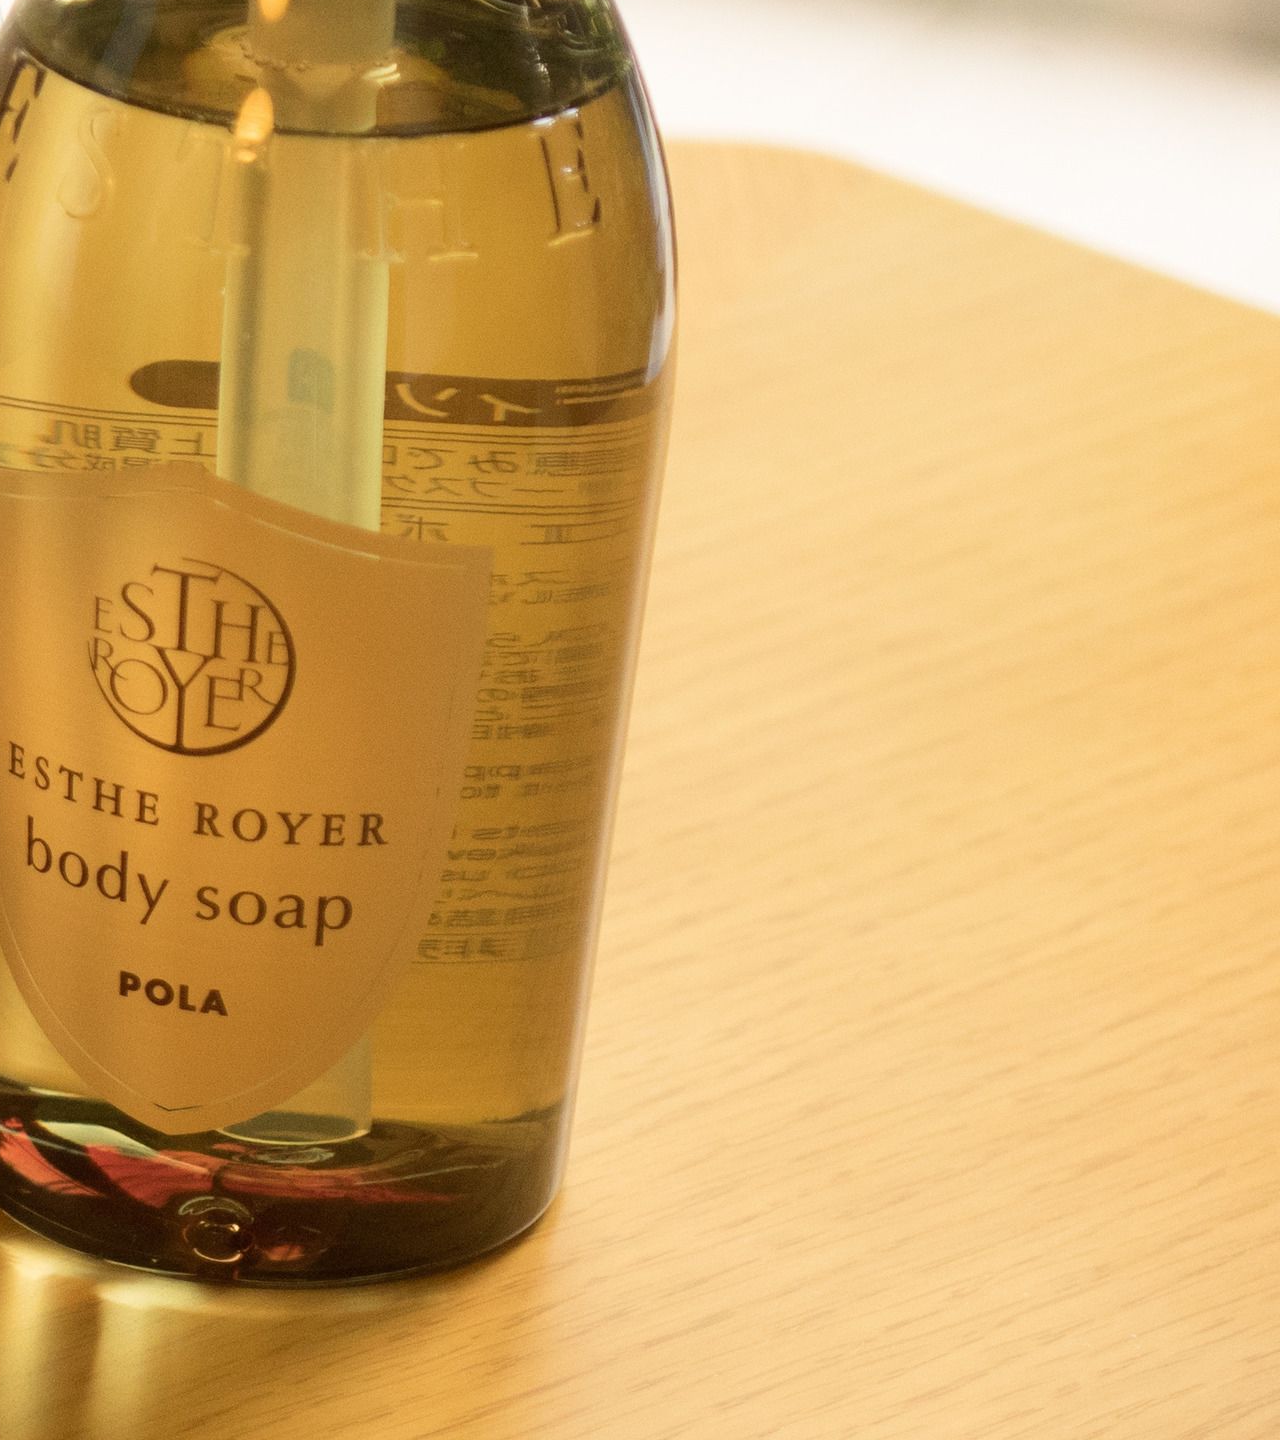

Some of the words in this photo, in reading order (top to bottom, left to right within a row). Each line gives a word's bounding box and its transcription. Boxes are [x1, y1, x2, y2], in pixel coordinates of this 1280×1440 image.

[8, 740, 160, 827] ESTHE
[192, 800, 389, 848] ROYER
[26, 814, 170, 926] body
[194, 883, 353, 947] soap
[118, 970, 229, 1017] POLA
